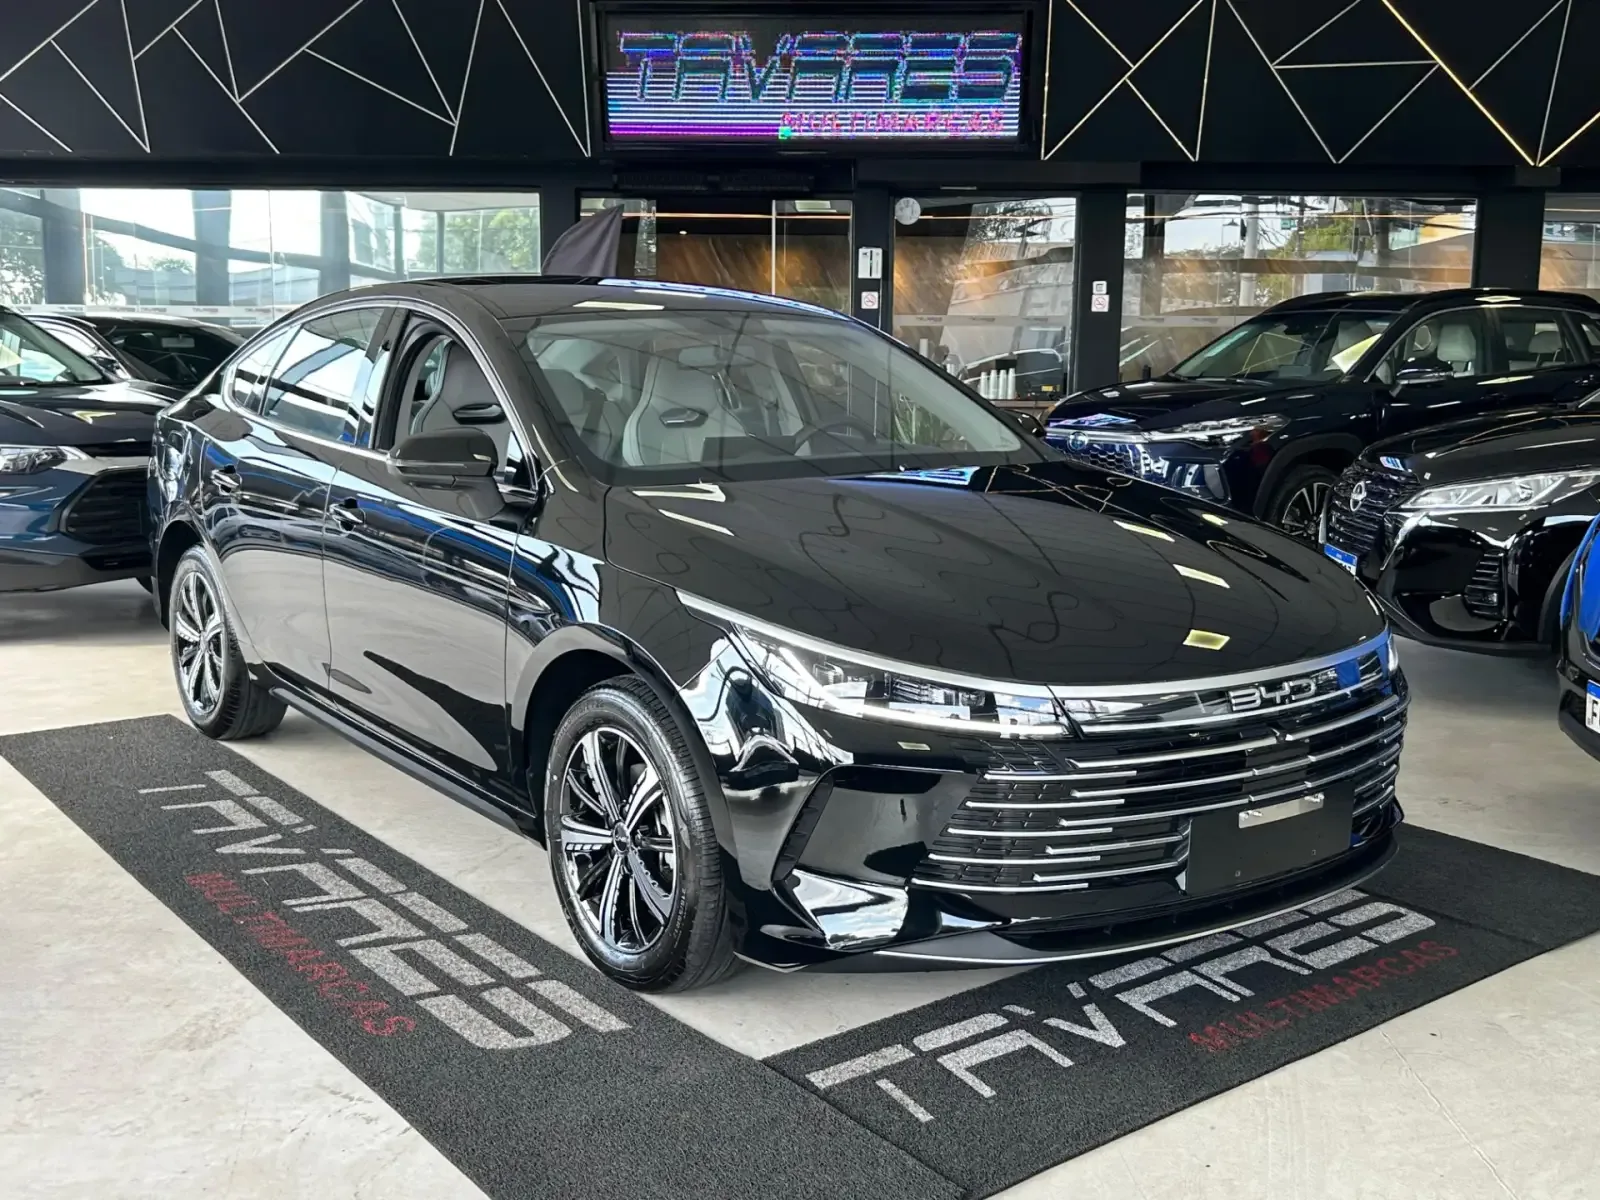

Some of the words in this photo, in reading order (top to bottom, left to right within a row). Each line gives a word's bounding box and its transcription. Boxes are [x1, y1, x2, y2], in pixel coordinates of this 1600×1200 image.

[1228, 678, 1318, 712] BYD
[805, 888, 1437, 1124] TAVARES
[1188, 940, 1461, 1053] MULTIMARCAS
